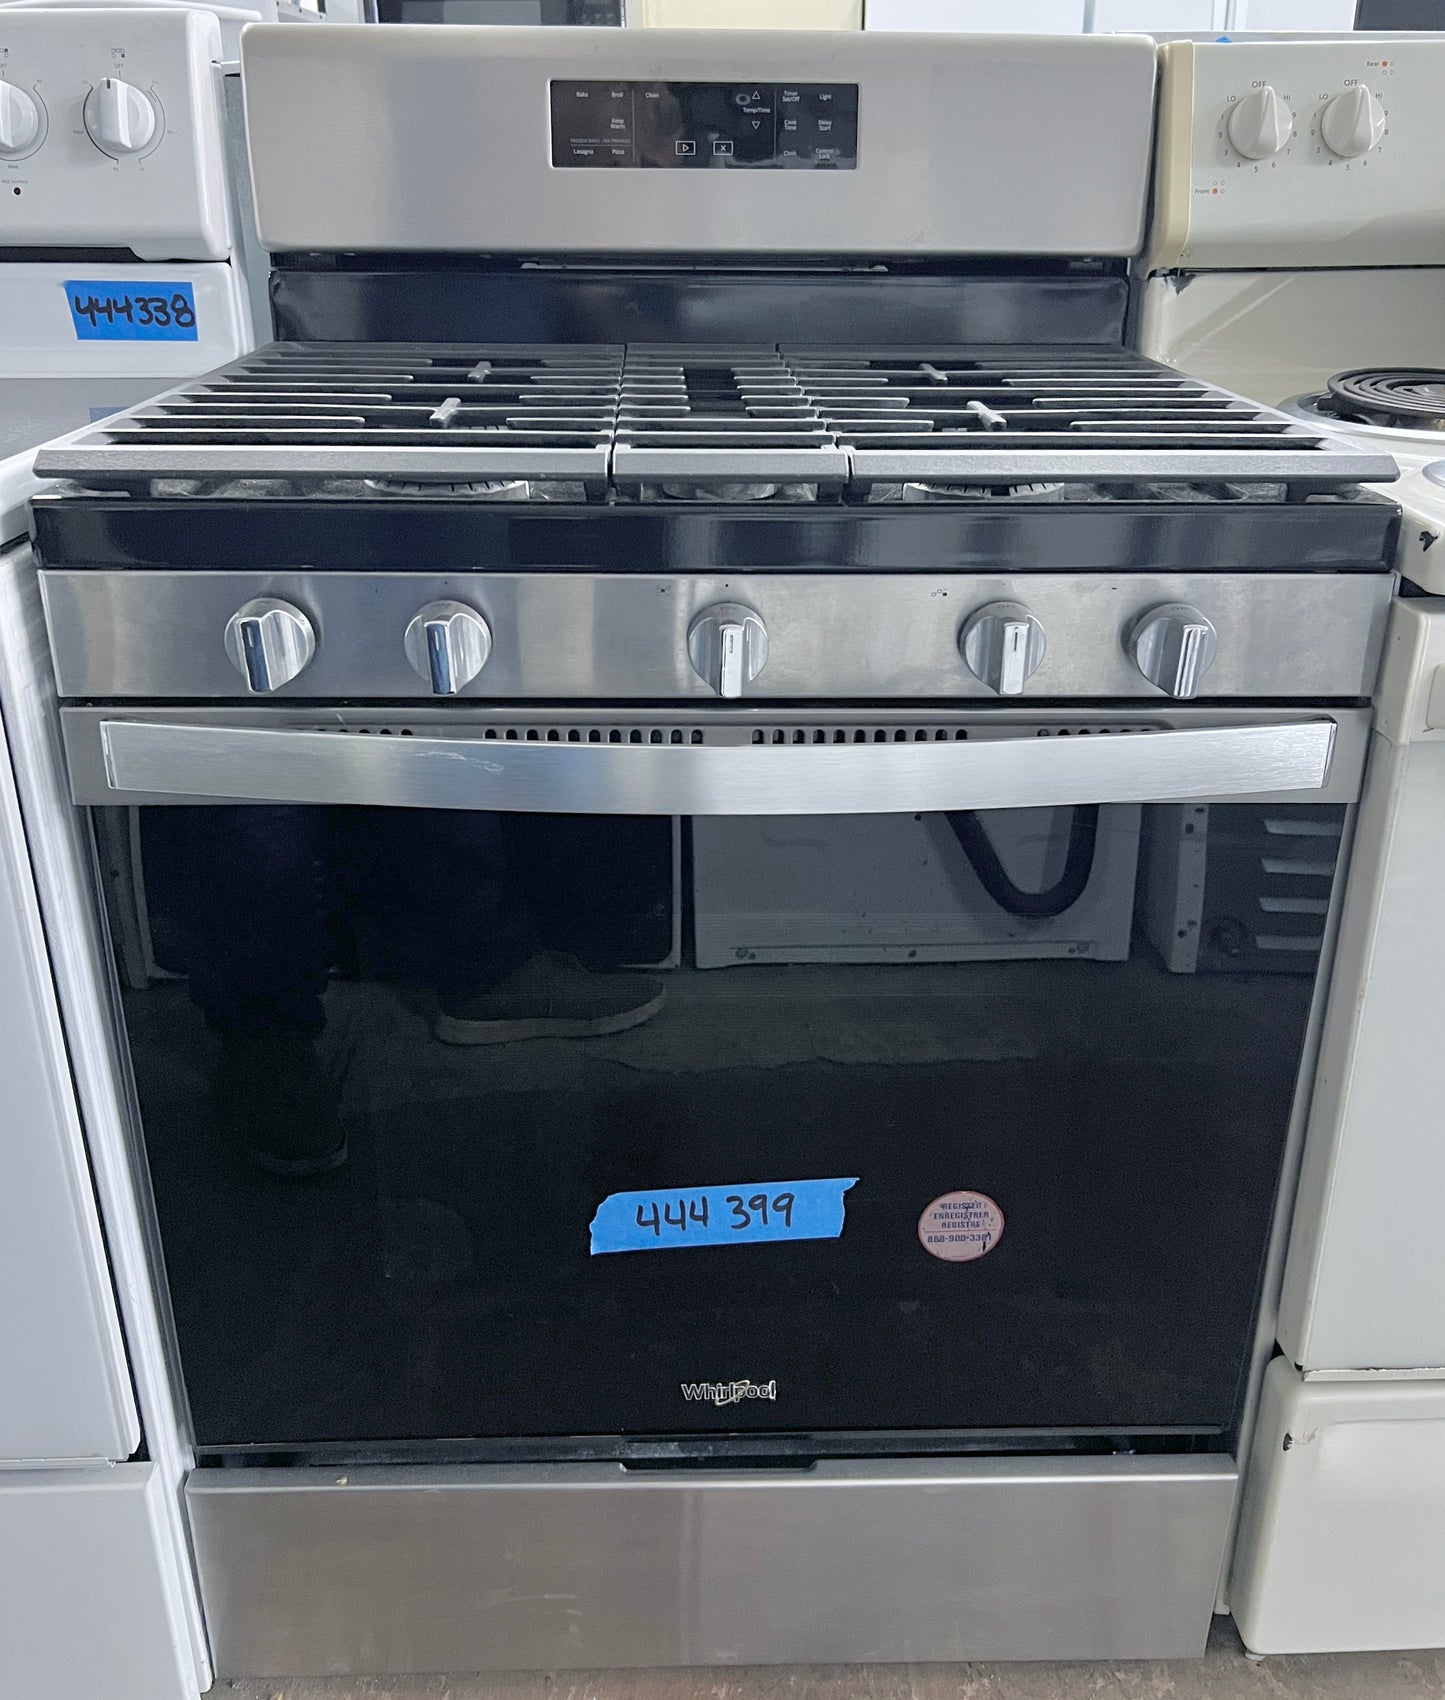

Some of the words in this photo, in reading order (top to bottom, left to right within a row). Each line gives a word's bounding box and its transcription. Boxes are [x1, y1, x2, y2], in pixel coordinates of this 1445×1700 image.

[75, 294, 196, 328] 444338
[636, 1196, 709, 1236] 444
[726, 1192, 795, 1230] 399
[680, 1380, 776, 1405] Whirlpool
